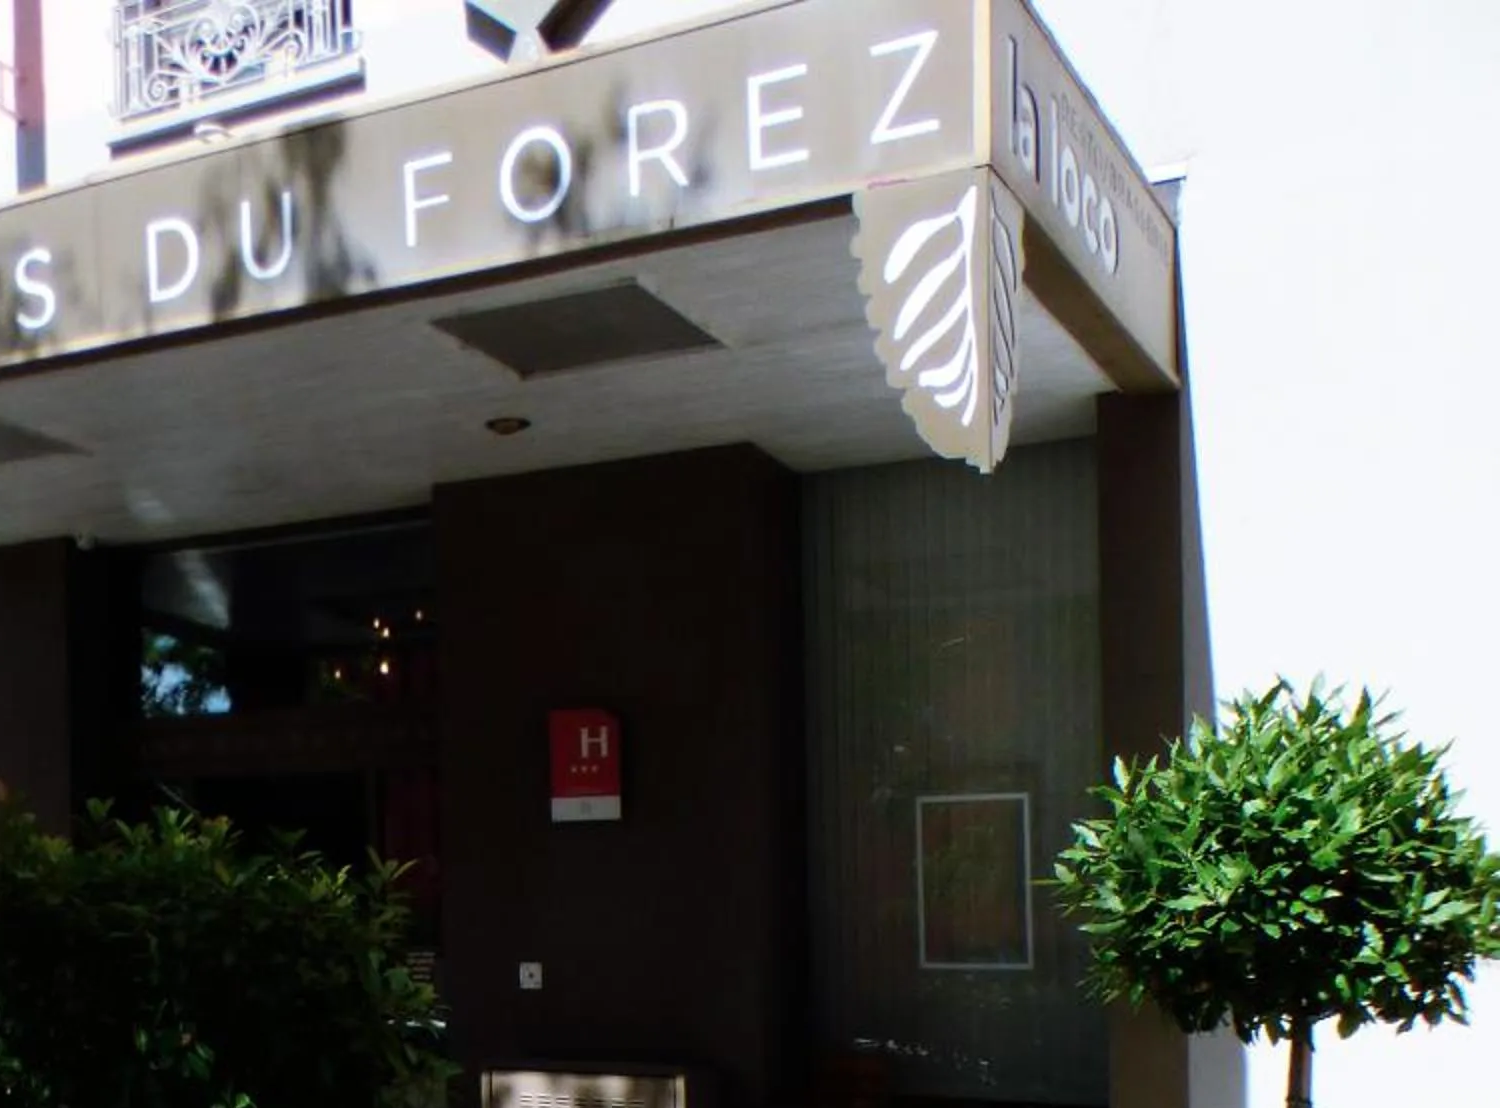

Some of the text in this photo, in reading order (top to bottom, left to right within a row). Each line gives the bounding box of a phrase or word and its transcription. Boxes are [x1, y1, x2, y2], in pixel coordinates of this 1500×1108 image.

[145, 190, 294, 304] DU
[401, 28, 942, 249] FOREZ
[1007, 35, 1120, 276] la loco
[580, 725, 609, 758] H
